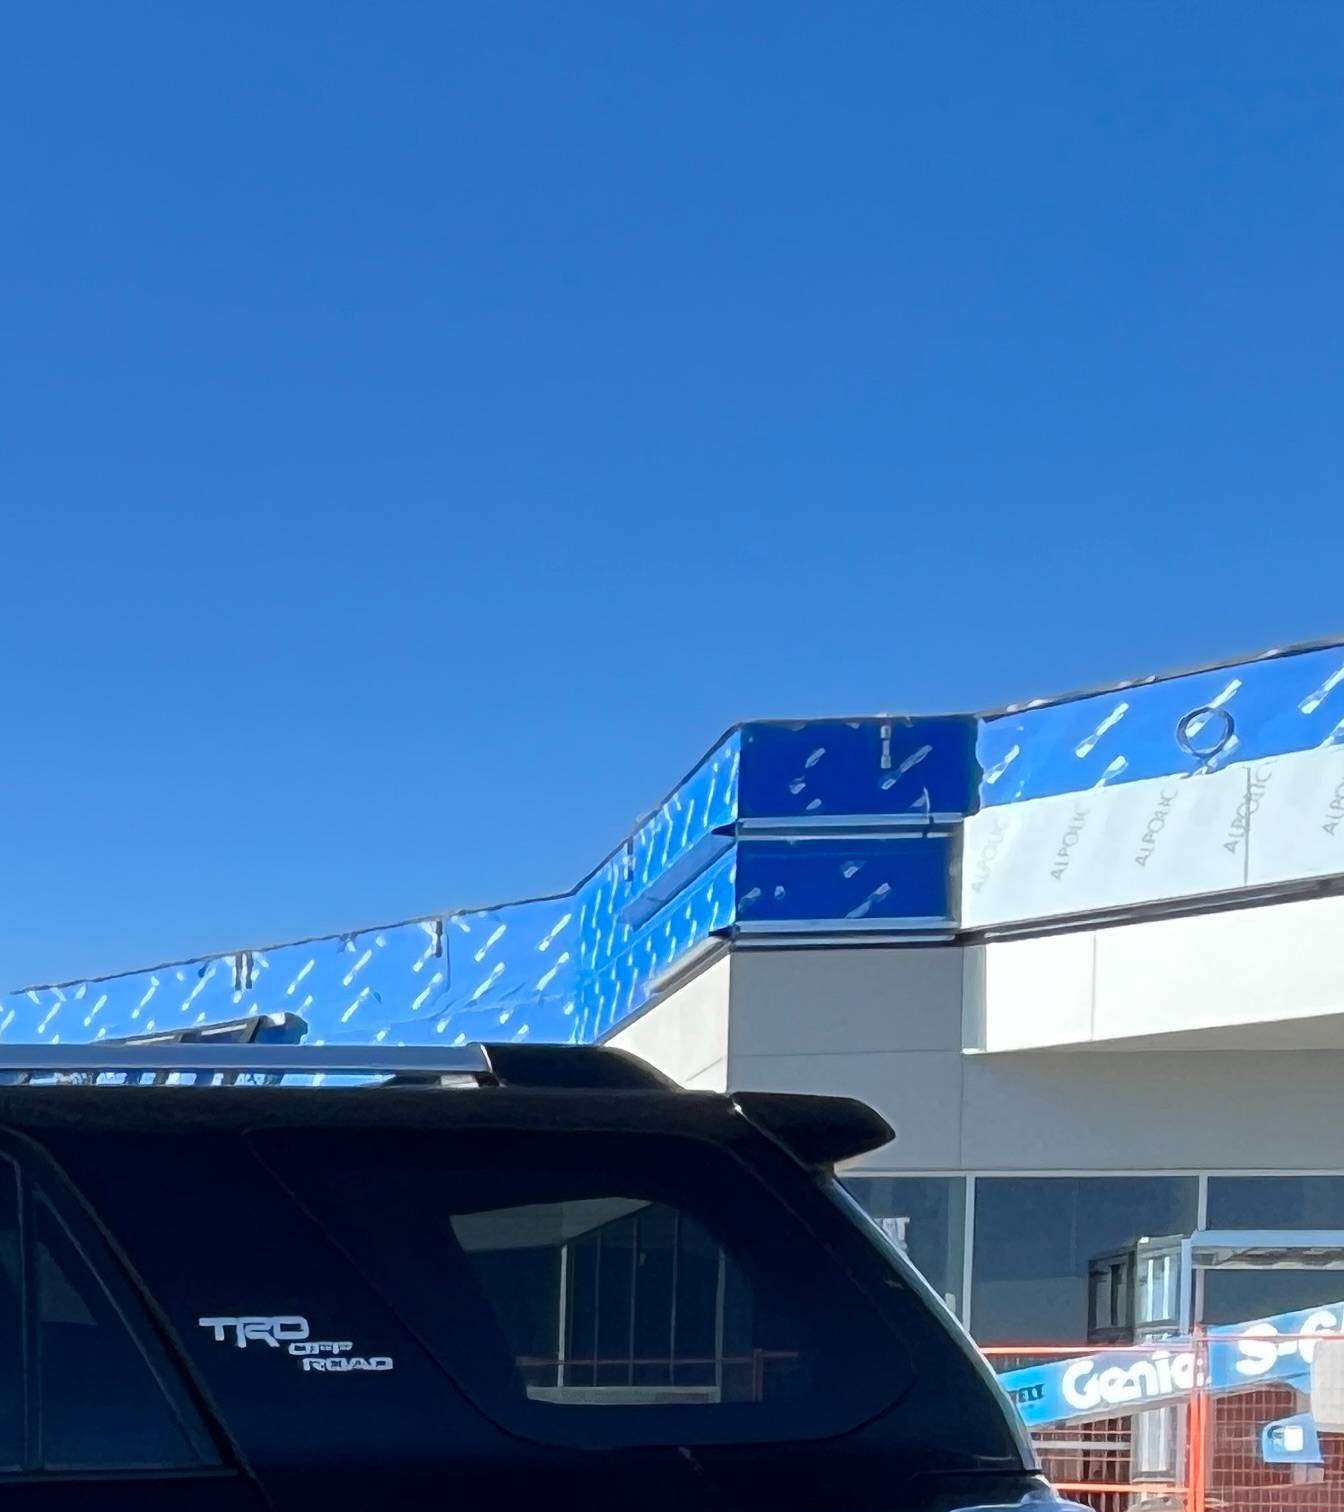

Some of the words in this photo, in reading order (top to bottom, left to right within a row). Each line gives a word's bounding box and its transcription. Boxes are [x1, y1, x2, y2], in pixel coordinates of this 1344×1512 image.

[199, 1315, 310, 1348] TRD
[288, 1341, 353, 1355] OFF
[302, 1357, 394, 1371] ROAD
